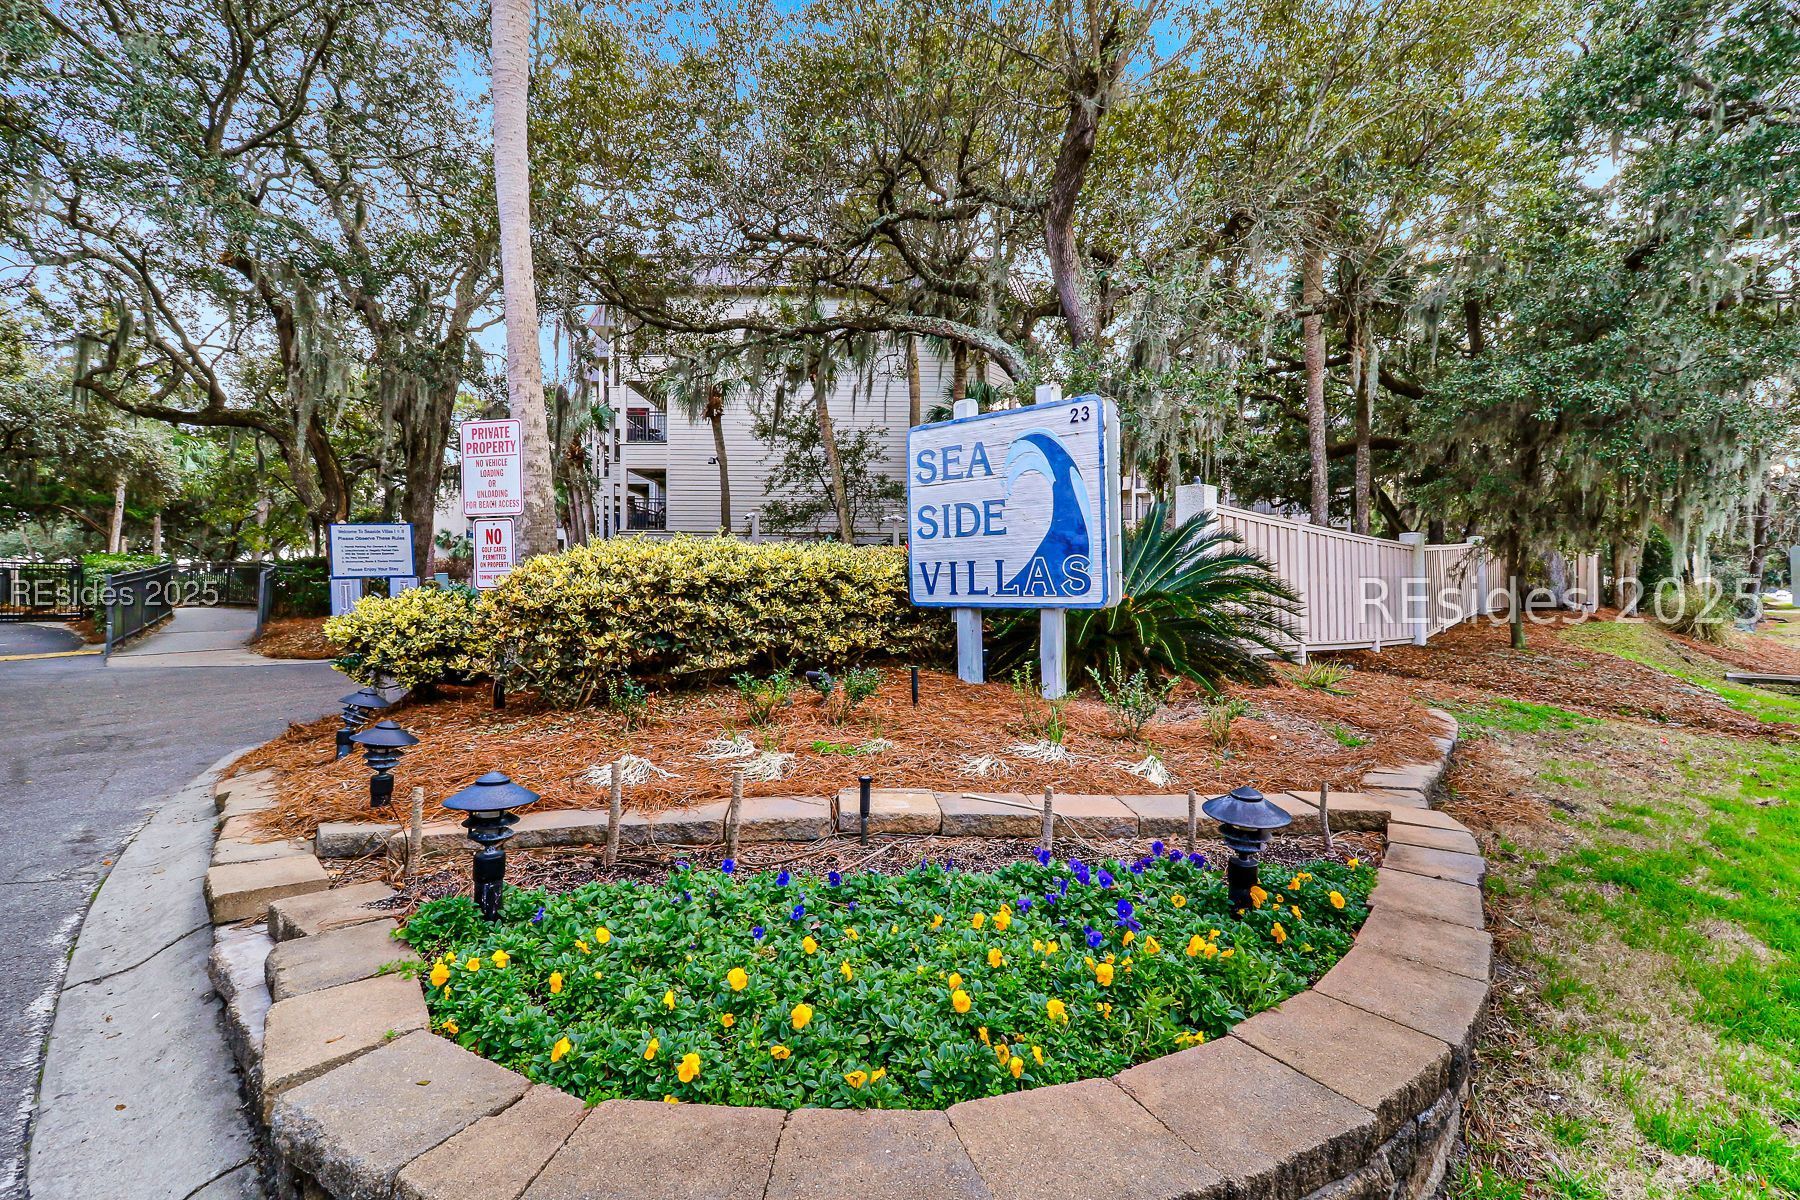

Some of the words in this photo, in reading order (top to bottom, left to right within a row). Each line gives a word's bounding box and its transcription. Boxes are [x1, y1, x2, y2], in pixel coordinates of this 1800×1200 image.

[1069, 405, 1090, 424] 23
[471, 426, 510, 440] PRIVATE
[466, 440, 516, 454] PROPERTY
[475, 459, 484, 468] NO
[485, 458, 508, 467] VEHICLE
[915, 441, 994, 484] SEA
[480, 468, 504, 478] LOADING
[488, 479, 496, 488] OR
[476, 489, 508, 499] UNLOADING
[465, 501, 477, 509] FOR
[479, 500, 497, 509] BEACH
[498, 499, 520, 508] ACCESS
[916, 499, 1007, 540] SIDE
[485, 528, 502, 545] NO
[919, 554, 1092, 597] VILLAS
